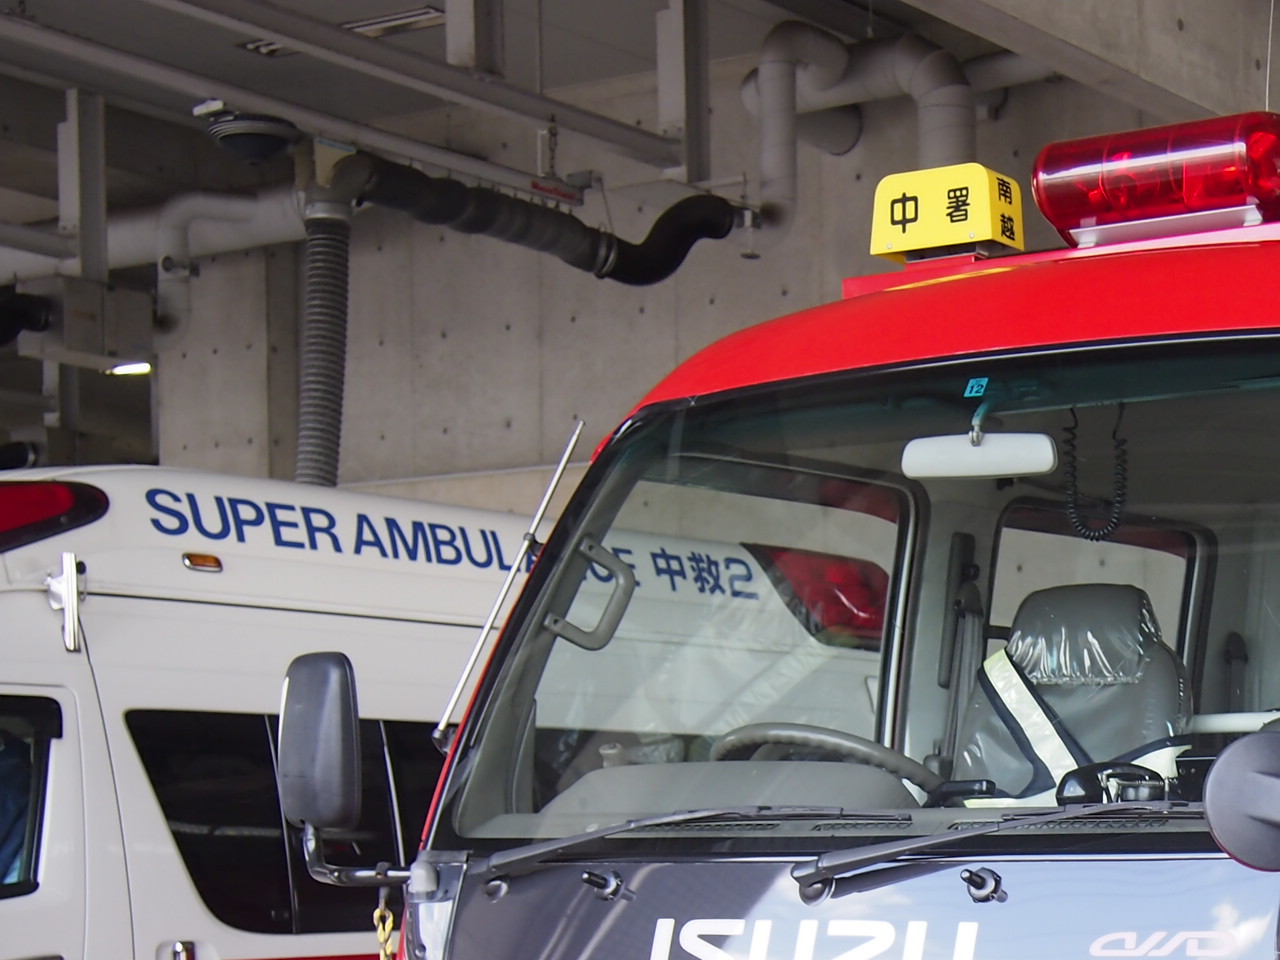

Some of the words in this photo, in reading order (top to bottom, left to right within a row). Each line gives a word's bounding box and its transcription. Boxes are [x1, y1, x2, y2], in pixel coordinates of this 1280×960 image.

[890, 187, 970, 234] 中署
[969, 384, 984, 394] 12
[145, 488, 343, 553] SUPER
